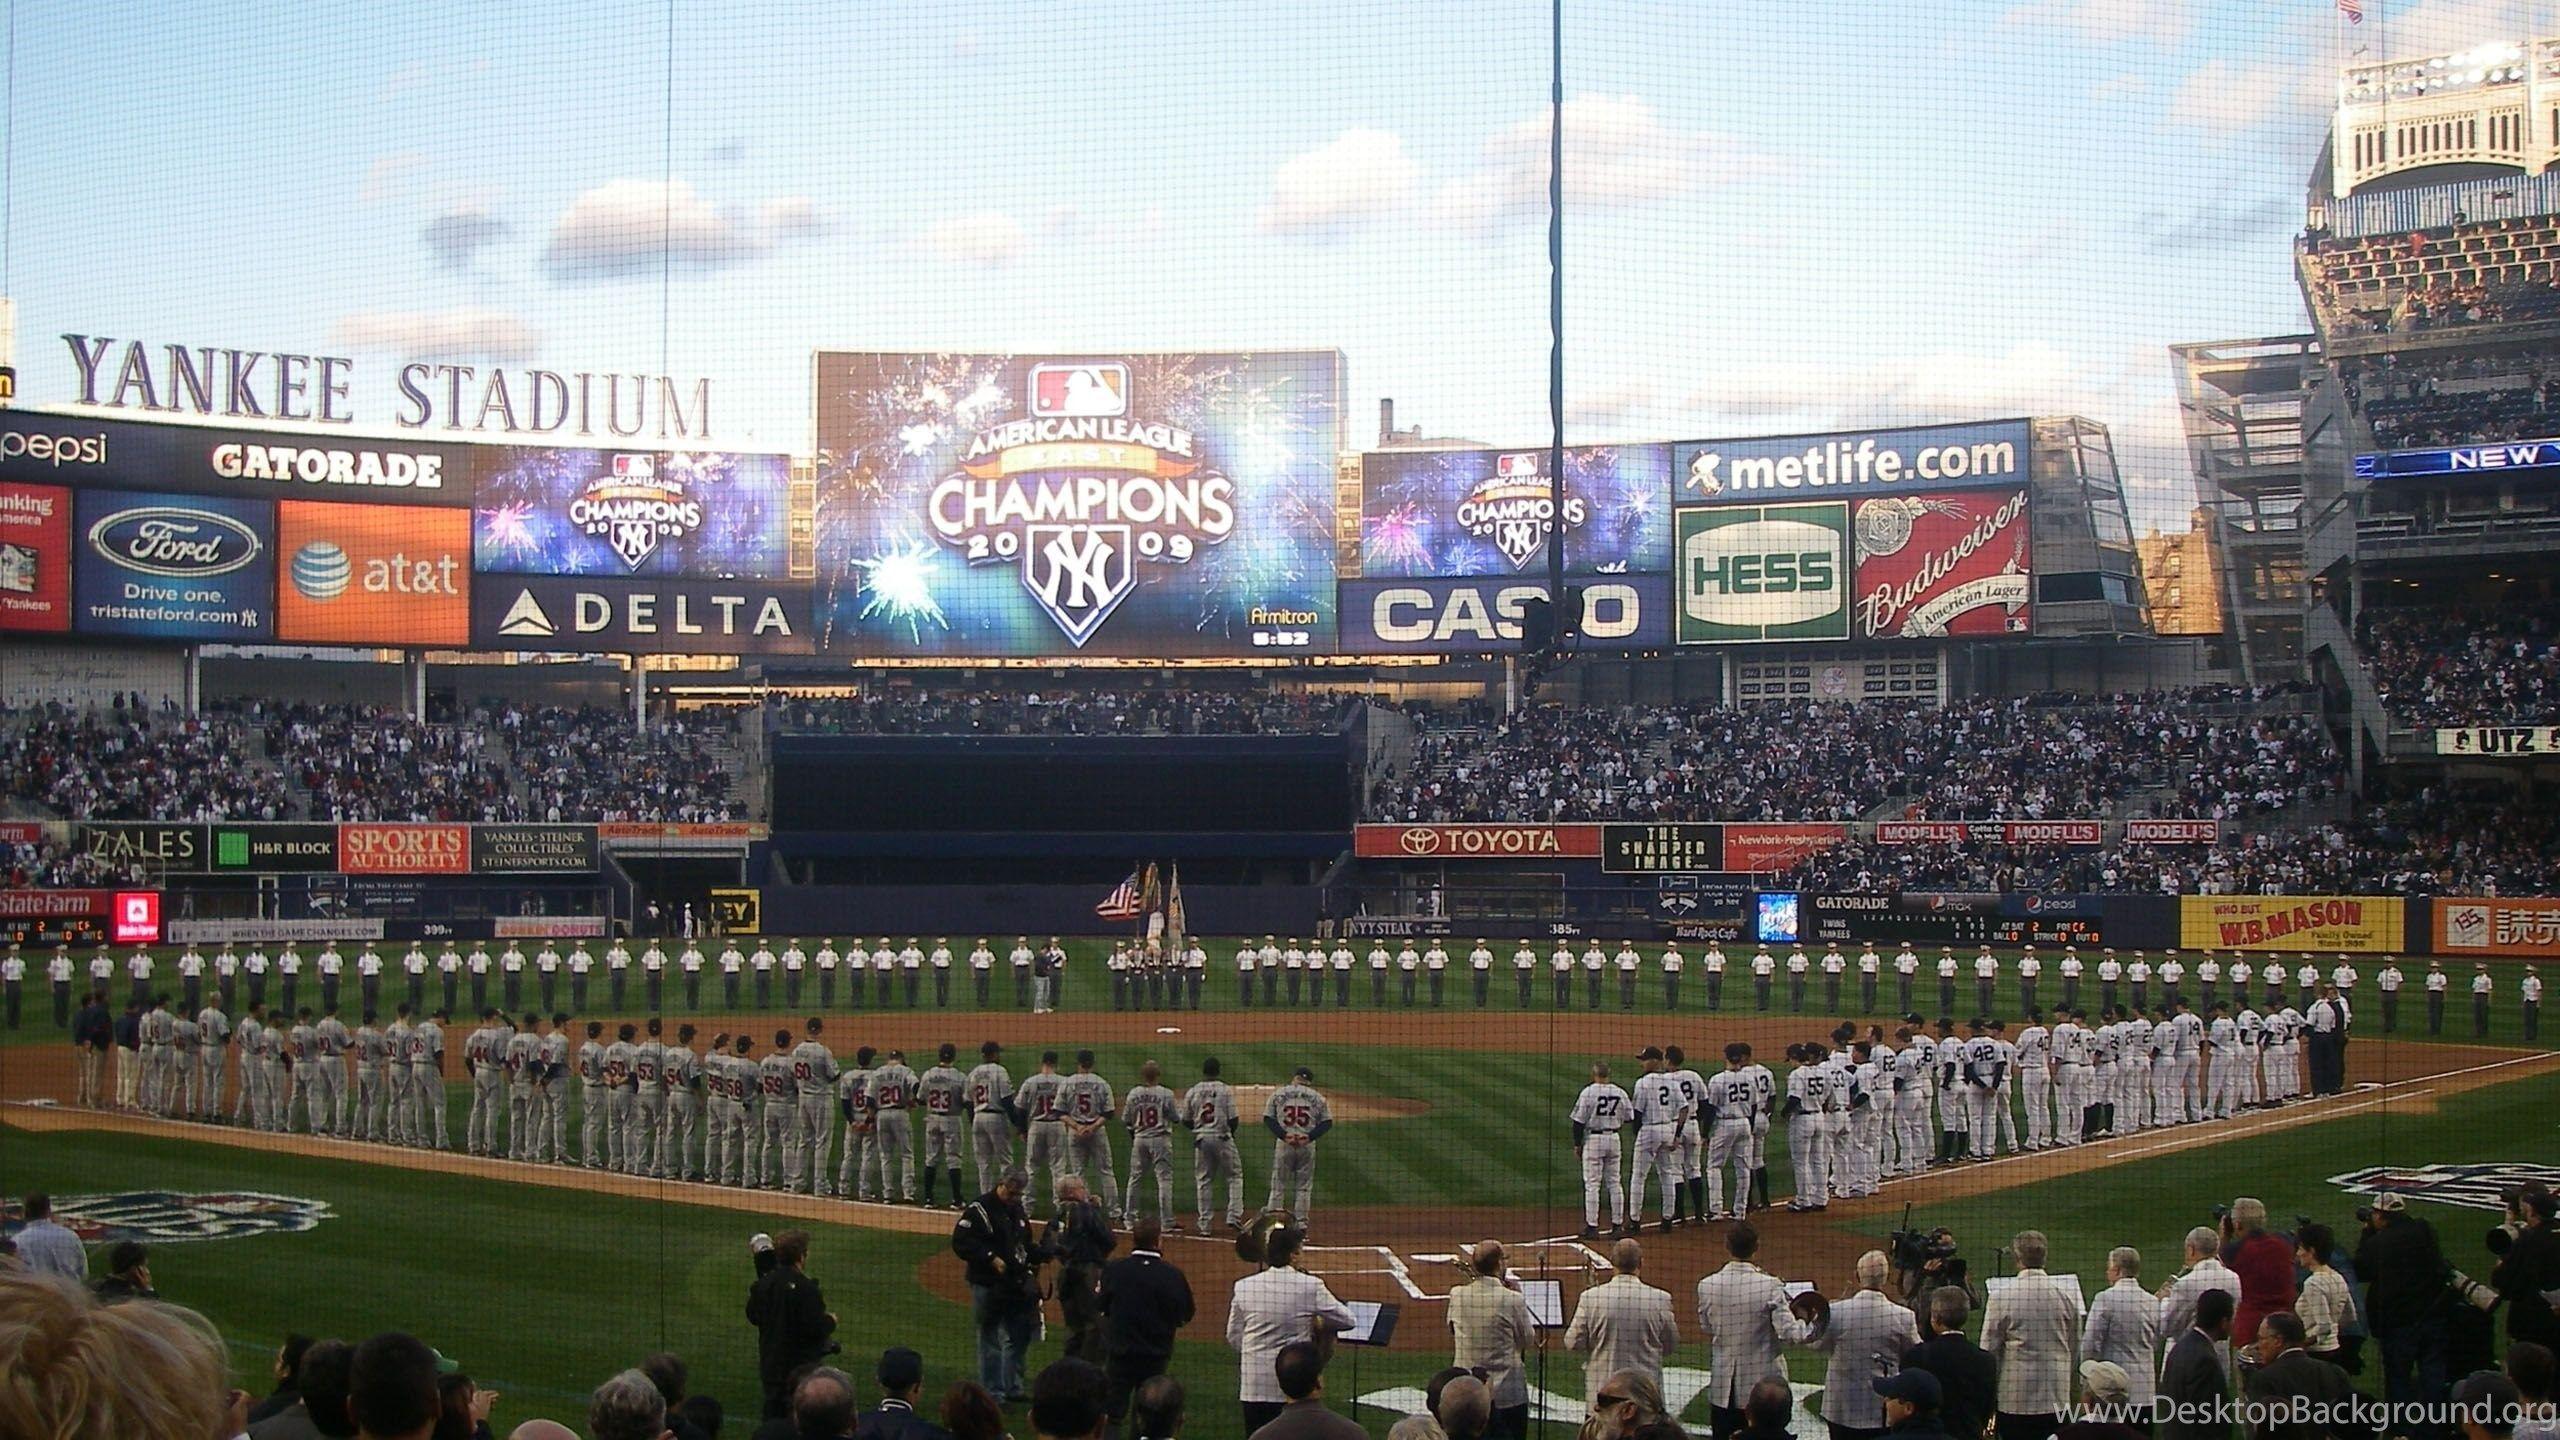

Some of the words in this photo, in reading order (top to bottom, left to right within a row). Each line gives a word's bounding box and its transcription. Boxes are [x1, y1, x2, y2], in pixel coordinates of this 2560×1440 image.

[60, 333, 355, 424] YANKEE
[395, 361, 714, 439] STADIUM
[1, 431, 108, 468] pepsi
[968, 418, 1097, 462] AMERICAN
[1101, 418, 1194, 458] LEAGUE
[212, 442, 443, 489] GATORADE
[1731, 439, 2015, 490] metlife.com
[2450, 447, 2539, 469] NEW
[0, 493, 53, 516] nking
[570, 499, 702, 528] CHAMPIONS
[929, 475, 1235, 540] CHAMPIONS
[130, 521, 222, 563] Ford
[968, 534, 1018, 560] 20
[1138, 533, 1195, 560] 09
[365, 551, 460, 596] at&t
[1693, 551, 1833, 595] HESS
[1857, 489, 2029, 638] Budweiser
[124, 583, 178, 602] Drive
[184, 589, 226, 604] one.
[90, 605, 238, 624] tristateford.com
[575, 592, 793, 636] DELTA
[1251, 607, 1318, 625] Armitron
[1373, 584, 1640, 642] CASO
[1924, 589, 1982, 628] American
[1986, 584, 2024, 598] Lager
[2479, 728, 2535, 752] UTZ
[690, 825, 748, 836] AutoTrader
[1647, 827, 1679, 841] THE
[1884, 825, 1960, 840] MODELL'S
[2014, 825, 2094, 840] MODELL'S
[2131, 823, 2217, 839] MODELL'S
[91, 830, 194, 858] ZALES
[253, 842, 283, 855] H&R
[287, 842, 331, 855] BLOCK
[347, 829, 462, 854] SPORTS
[495, 843, 574, 854] COLLECTIBLES
[1445, 829, 1561, 853] TOYOTA
[1621, 841, 1705, 855] SHARPER
[348, 853, 461, 868] AUTHORITY
[481, 857, 587, 867] STEINERSPORTS.COM
[48, 894, 92, 913] Farm
[1816, 896, 1889, 910] GATORADE
[1946, 901, 1972, 911] max
[2043, 899, 2077, 912] pepsi
[2214, 904, 2237, 916] WHO
[2241, 903, 2262, 915] BUT
[1377, 922, 1413, 935] STEAK
[1675, 926, 1698, 938] Hard
[1697, 926, 1719, 940] Rock
[1718, 927, 1739, 940] Cafe
[1823, 919, 1846, 929] TWINS
[2001, 922, 2011, 931] AT
[2032, 922, 2040, 932] 2
[1817, 929, 1851, 940] YANKEES
[1992, 932, 2010, 941] BALL
[2033, 932, 2059, 941] STRIKE
[2342, 930, 2373, 940] Owned
[1973, 1044, 1994, 1062] 42
[609, 1060, 626, 1078] 50
[638, 1062, 655, 1081] 53
[794, 1061, 812, 1081] 60
[727, 1079, 744, 1098] 58
[763, 1075, 784, 1096] 59
[879, 1085, 902, 1105] 20
[974, 1084, 990, 1105] 21
[1728, 1083, 1750, 1103] 25
[1807, 1076, 1824, 1096] 55
[928, 1089, 950, 1110] 23
[1076, 1093, 1092, 1115] 5
[1596, 1096, 1621, 1116] 27
[1659, 1086, 1669, 1106] 2
[1137, 1105, 1159, 1128] 18
[1201, 1102, 1216, 1124] 2
[1283, 1105, 1311, 1127] 35
